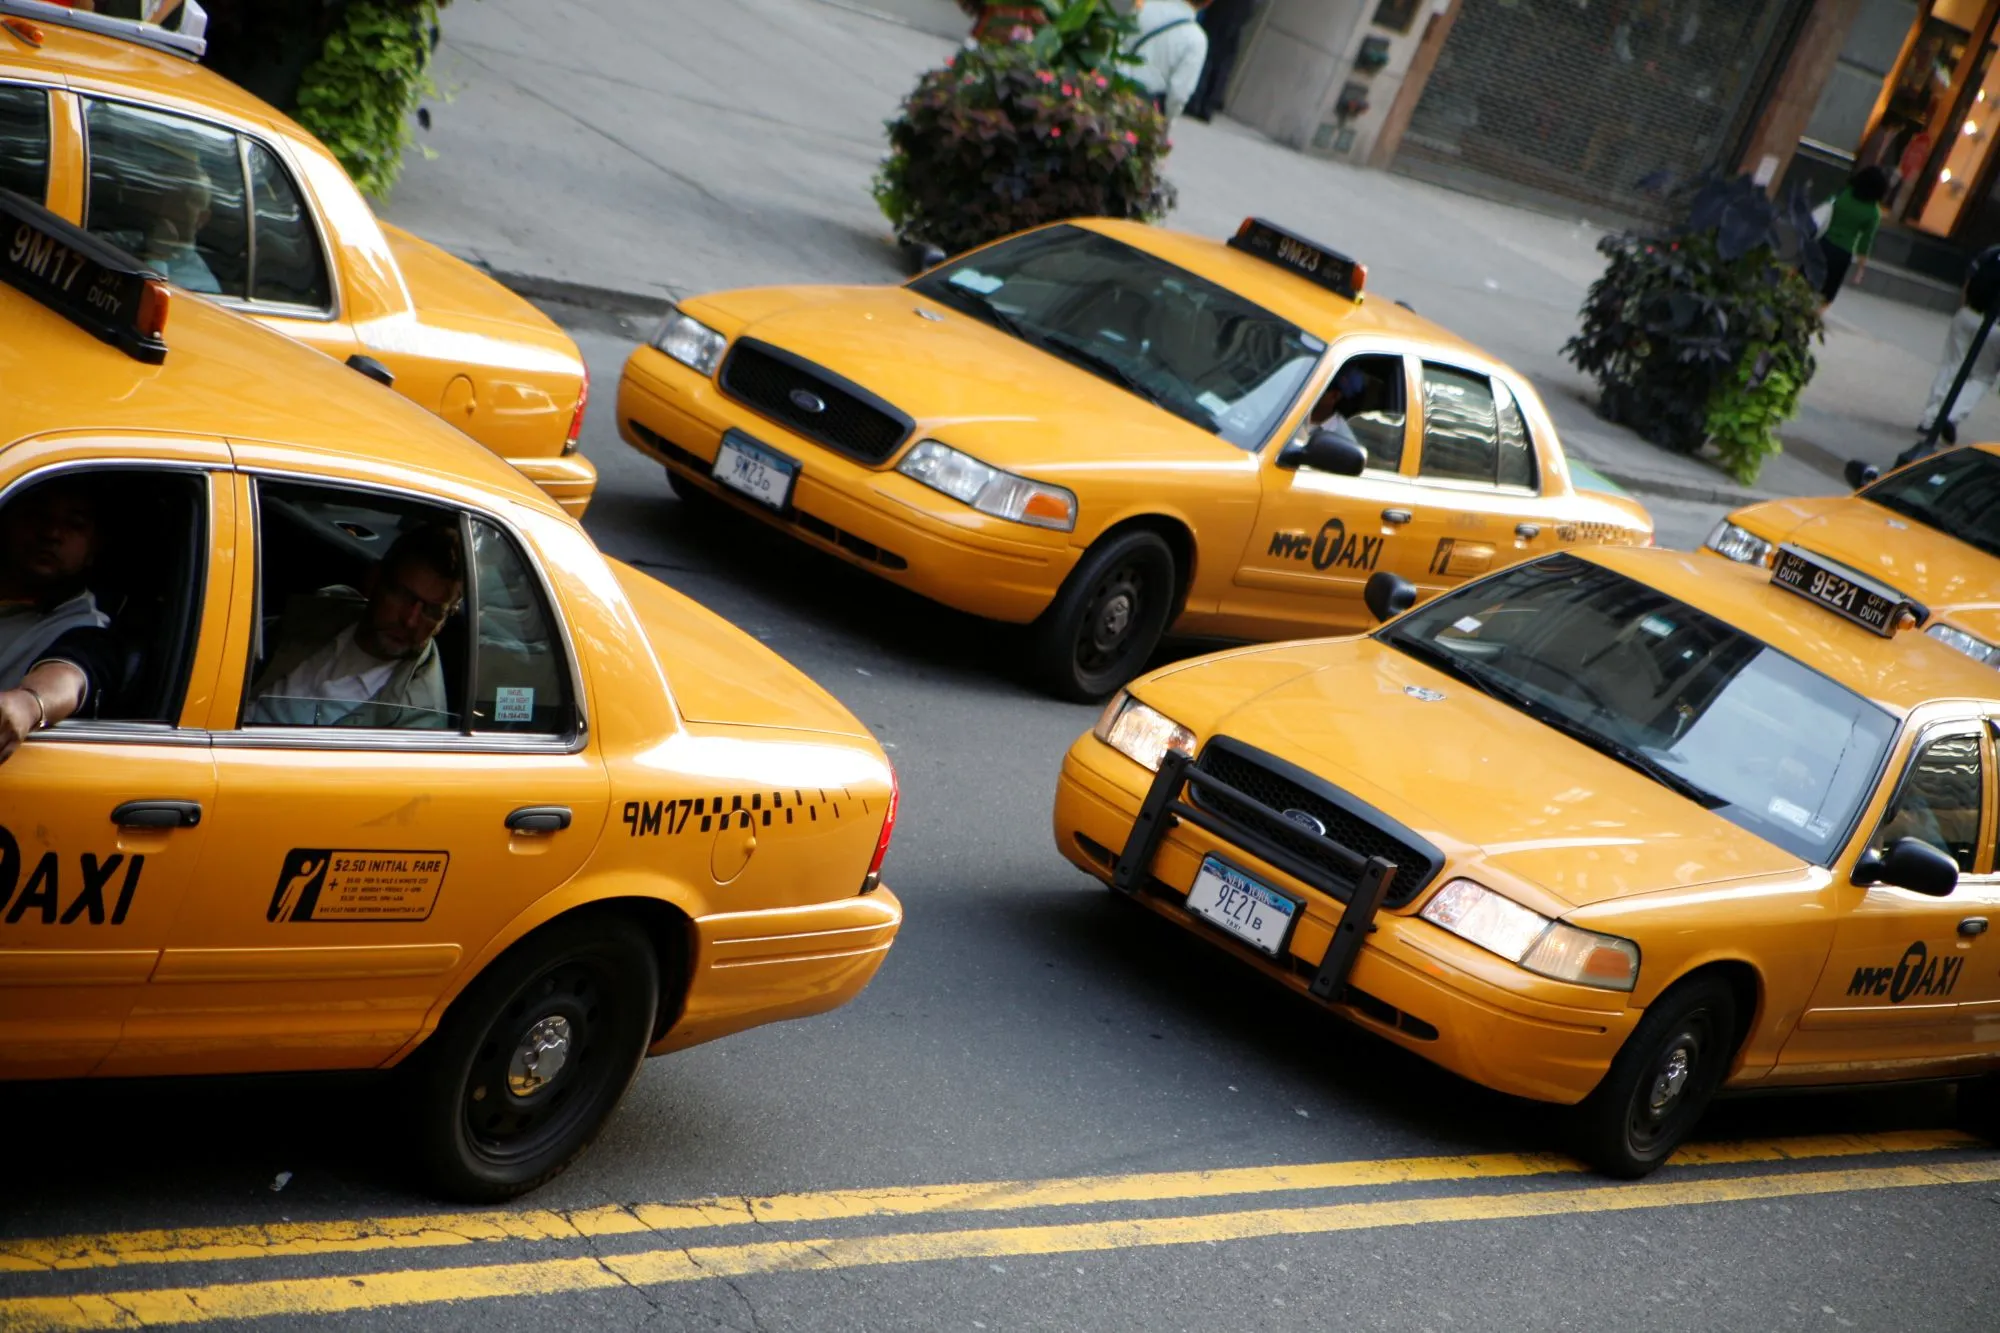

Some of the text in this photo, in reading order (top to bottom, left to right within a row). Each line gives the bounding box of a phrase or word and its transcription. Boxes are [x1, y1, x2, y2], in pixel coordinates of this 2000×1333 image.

[9, 225, 87, 292] 9M17
[1277, 237, 1320, 272] 9M23
[86, 285, 122, 315] DUTY
[1268, 518, 1384, 570] NYC TAXI
[1779, 567, 1803, 585] DUTY
[1787, 554, 1807, 570] OFF
[1810, 571, 1858, 611] 9E21
[1868, 594, 1886, 609] OFF
[1859, 605, 1885, 625] DUTY
[623, 799, 692, 837] 9M17
[0, 825, 145, 925] AXI
[334, 859, 442, 873] $2.50 INITIAL FARE
[1226, 919, 1241, 930] TAXI
[1846, 941, 1965, 1003] NYC TAXI
